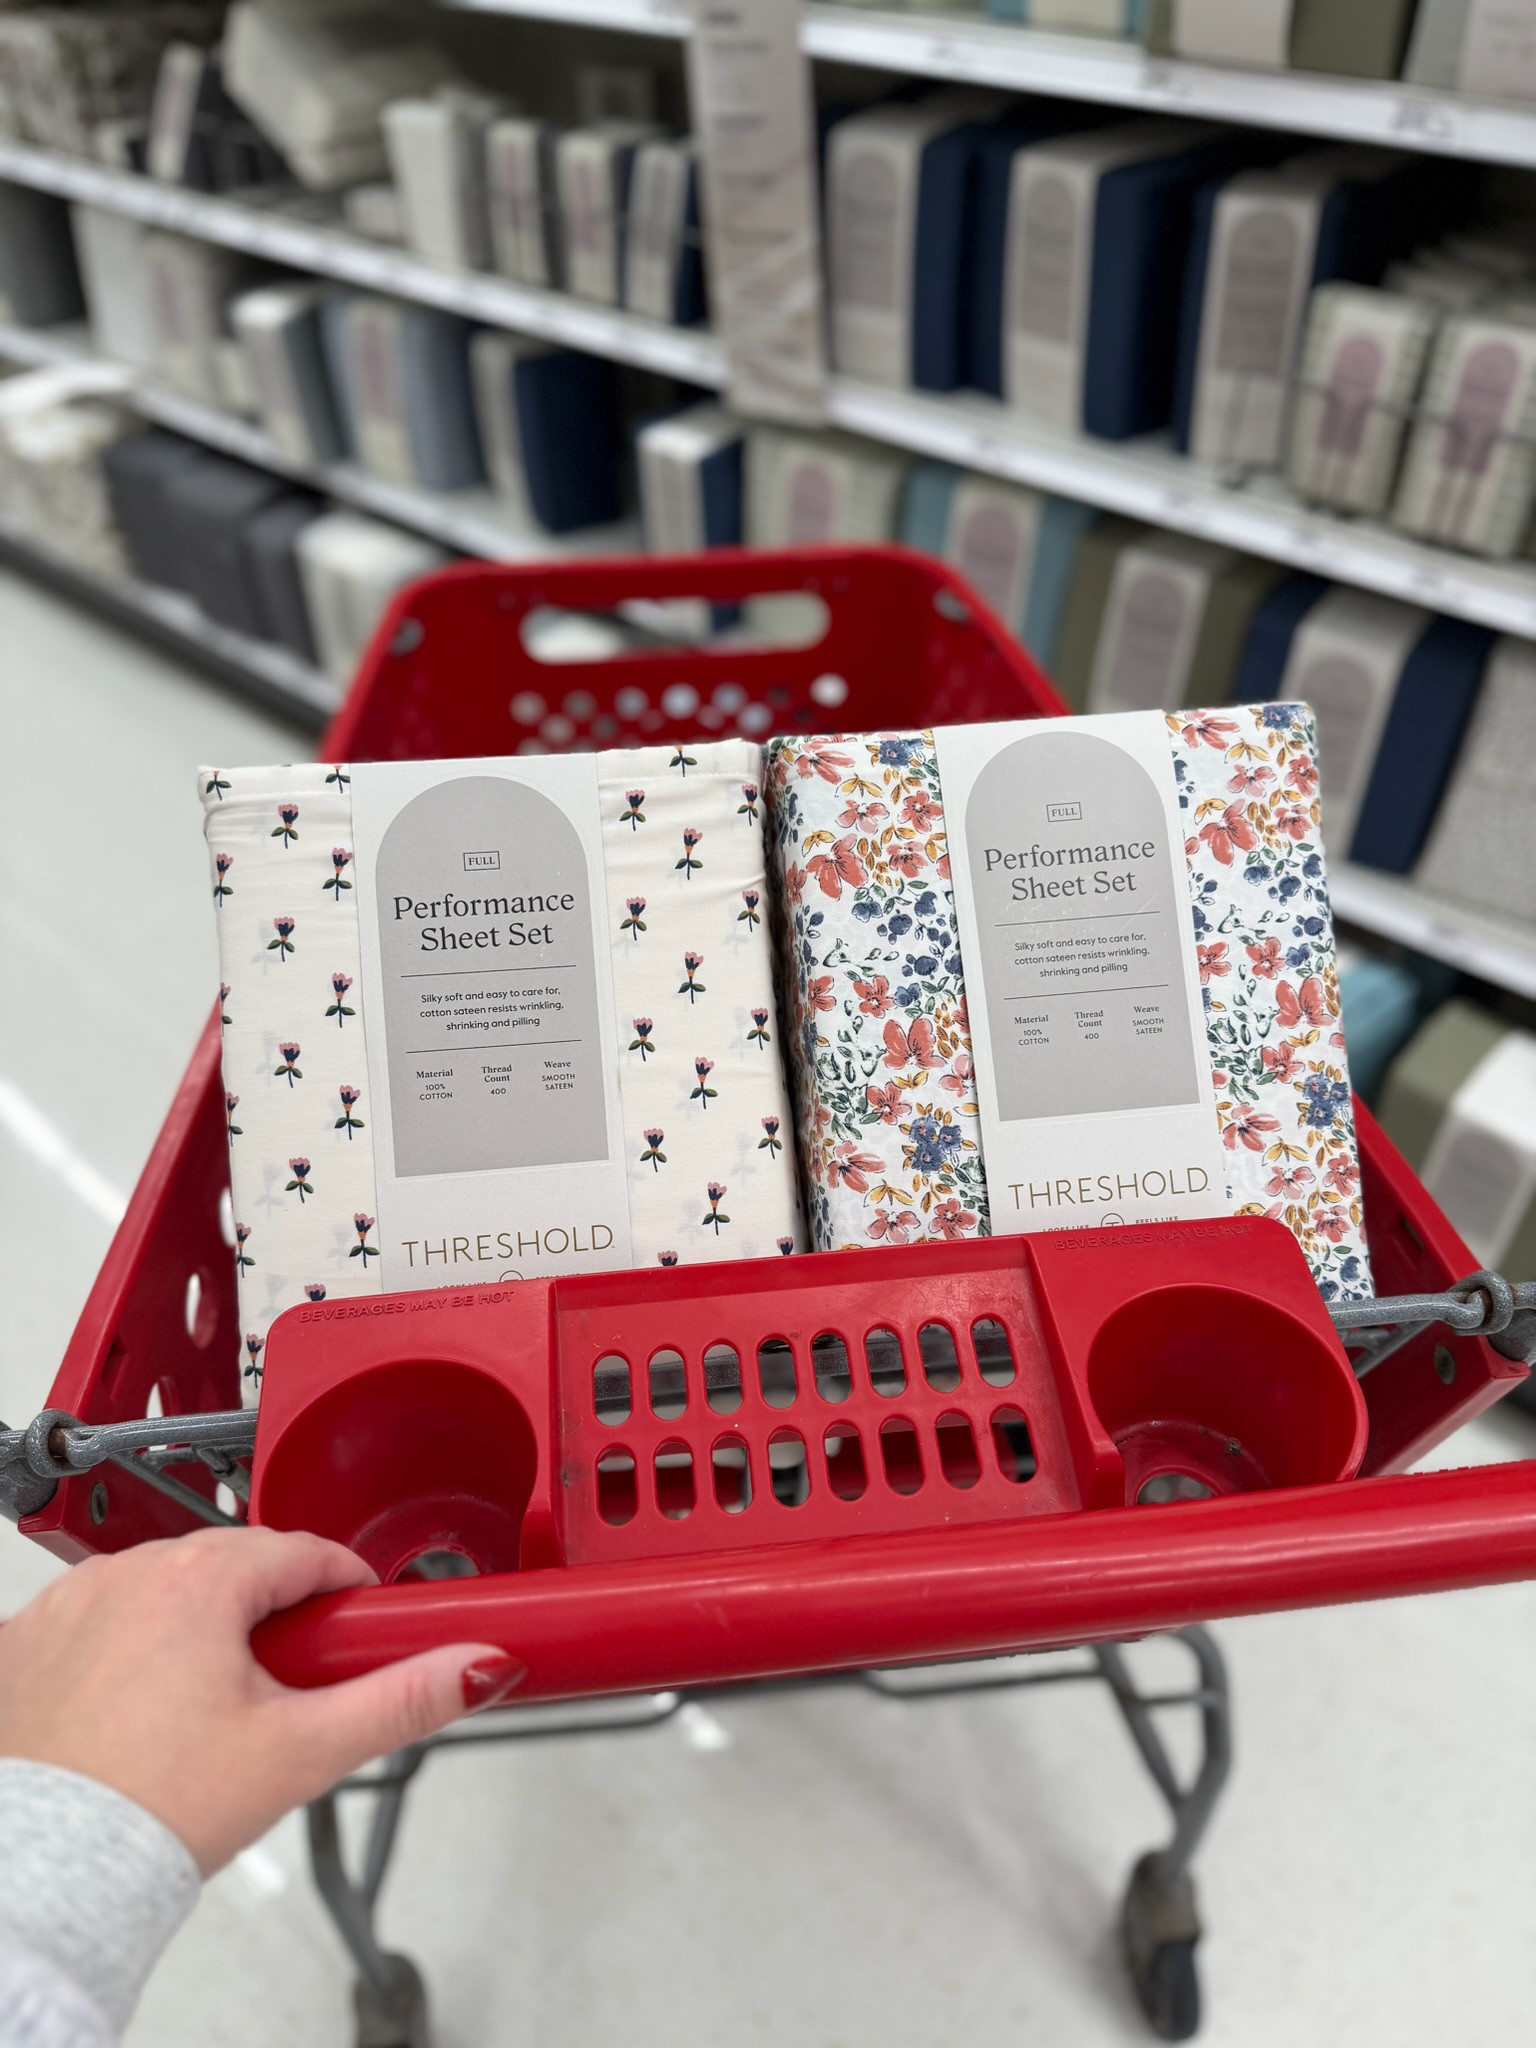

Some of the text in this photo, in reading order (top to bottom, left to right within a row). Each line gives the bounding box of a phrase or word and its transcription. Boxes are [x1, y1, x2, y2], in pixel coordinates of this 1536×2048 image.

[1051, 807, 1078, 817] FULL
[468, 856, 496, 866] FULL
[984, 840, 1156, 872] Performance
[1011, 870, 1138, 901] Sheet Set
[393, 893, 576, 921] Performance
[421, 922, 554, 952] Sheet Set
[1014, 942, 1035, 952] Silky
[1037, 940, 1054, 949] soft
[1056, 938, 1073, 948] and
[1075, 938, 1096, 946] easy
[1109, 935, 1130, 944] care
[1014, 956, 1044, 965] cotton
[1046, 954, 1076, 963] sateen
[1078, 950, 1106, 960] resists
[1040, 963, 1128, 978] shrinking and pilling
[421, 994, 442, 1004] Silky
[444, 993, 463, 1002] soft
[465, 991, 484, 1000] and
[486, 991, 508, 1000] easy
[509, 990, 520, 998] to
[522, 988, 544, 997] care
[420, 1009, 452, 1018] cotton
[454, 1006, 486, 1016] sateen
[488, 1004, 518, 1014] resists
[1074, 1010, 1104, 1019] Thread
[446, 1017, 540, 1031] shrinking and pilling
[1014, 1014, 1049, 1025] Material
[1078, 1020, 1102, 1028] Count
[1132, 1018, 1164, 1026] SMOOTH
[1023, 1029, 1042, 1037] 100%
[1136, 1027, 1163, 1035] SATEEN
[1018, 1037, 1049, 1046] COTTON
[481, 1064, 512, 1074] Thread
[544, 1061, 572, 1069] Weave
[416, 1069, 454, 1079] Material
[484, 1074, 510, 1083] Count
[542, 1073, 576, 1082] SMOOTH
[545, 1082, 574, 1091] SATEEN
[419, 1092, 453, 1101] COTTON
[1008, 1167, 1209, 1210] THRESHOLD
[1054, 1224, 1253, 1251] BEVERAGES MAY BE HOT
[401, 1224, 614, 1268] THRESHOLD
[300, 1291, 515, 1323] BEVERAGES MAY BE HOT
